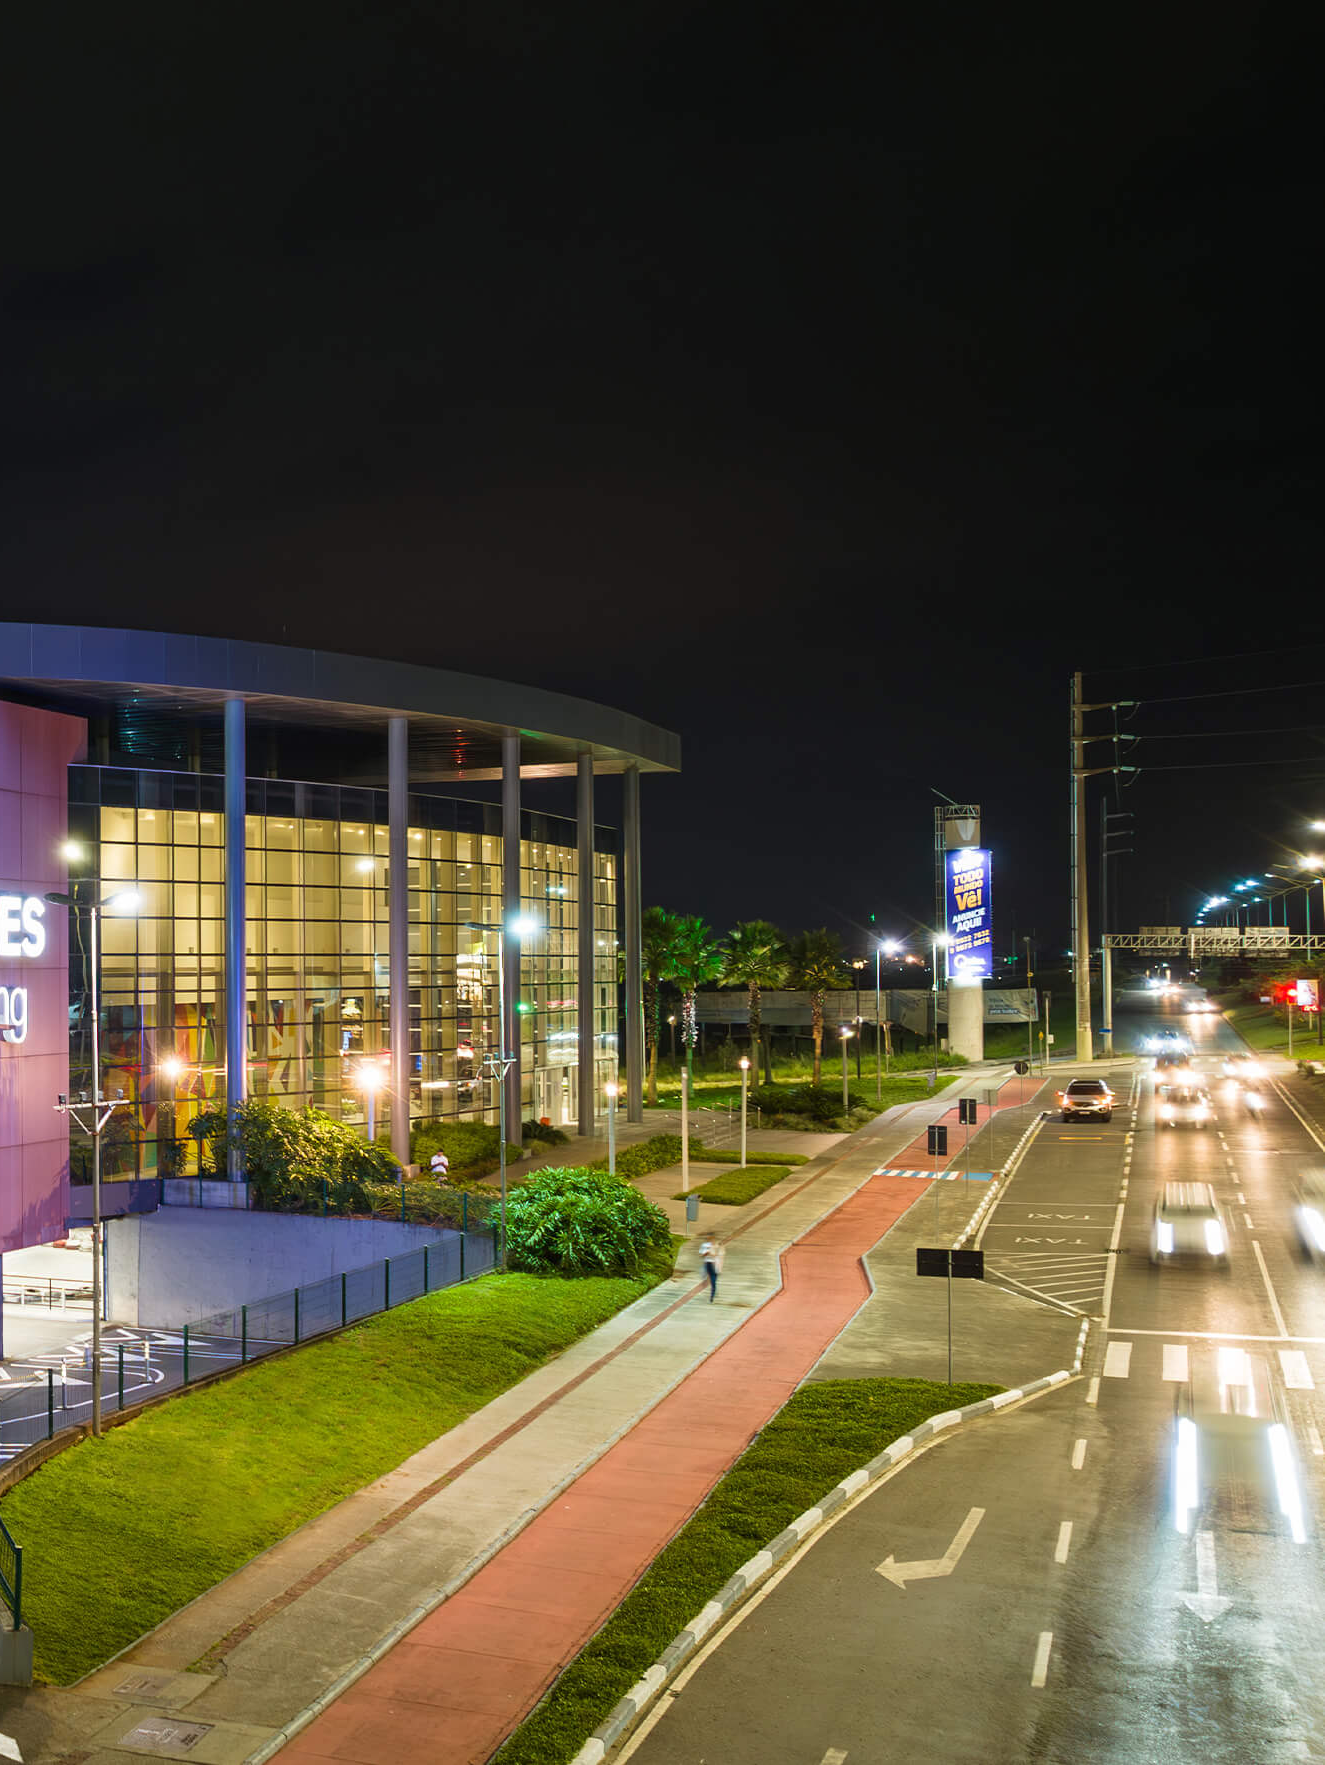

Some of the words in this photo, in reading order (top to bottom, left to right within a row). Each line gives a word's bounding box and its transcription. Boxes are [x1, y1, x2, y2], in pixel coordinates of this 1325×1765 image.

[953, 868, 984, 886] TODO
[955, 888, 982, 911] Vê!
[951, 907, 986, 924] ANUNCIE
[1027, 1213, 1098, 1221] TAXI
[1015, 1236, 1090, 1245] TAXI
